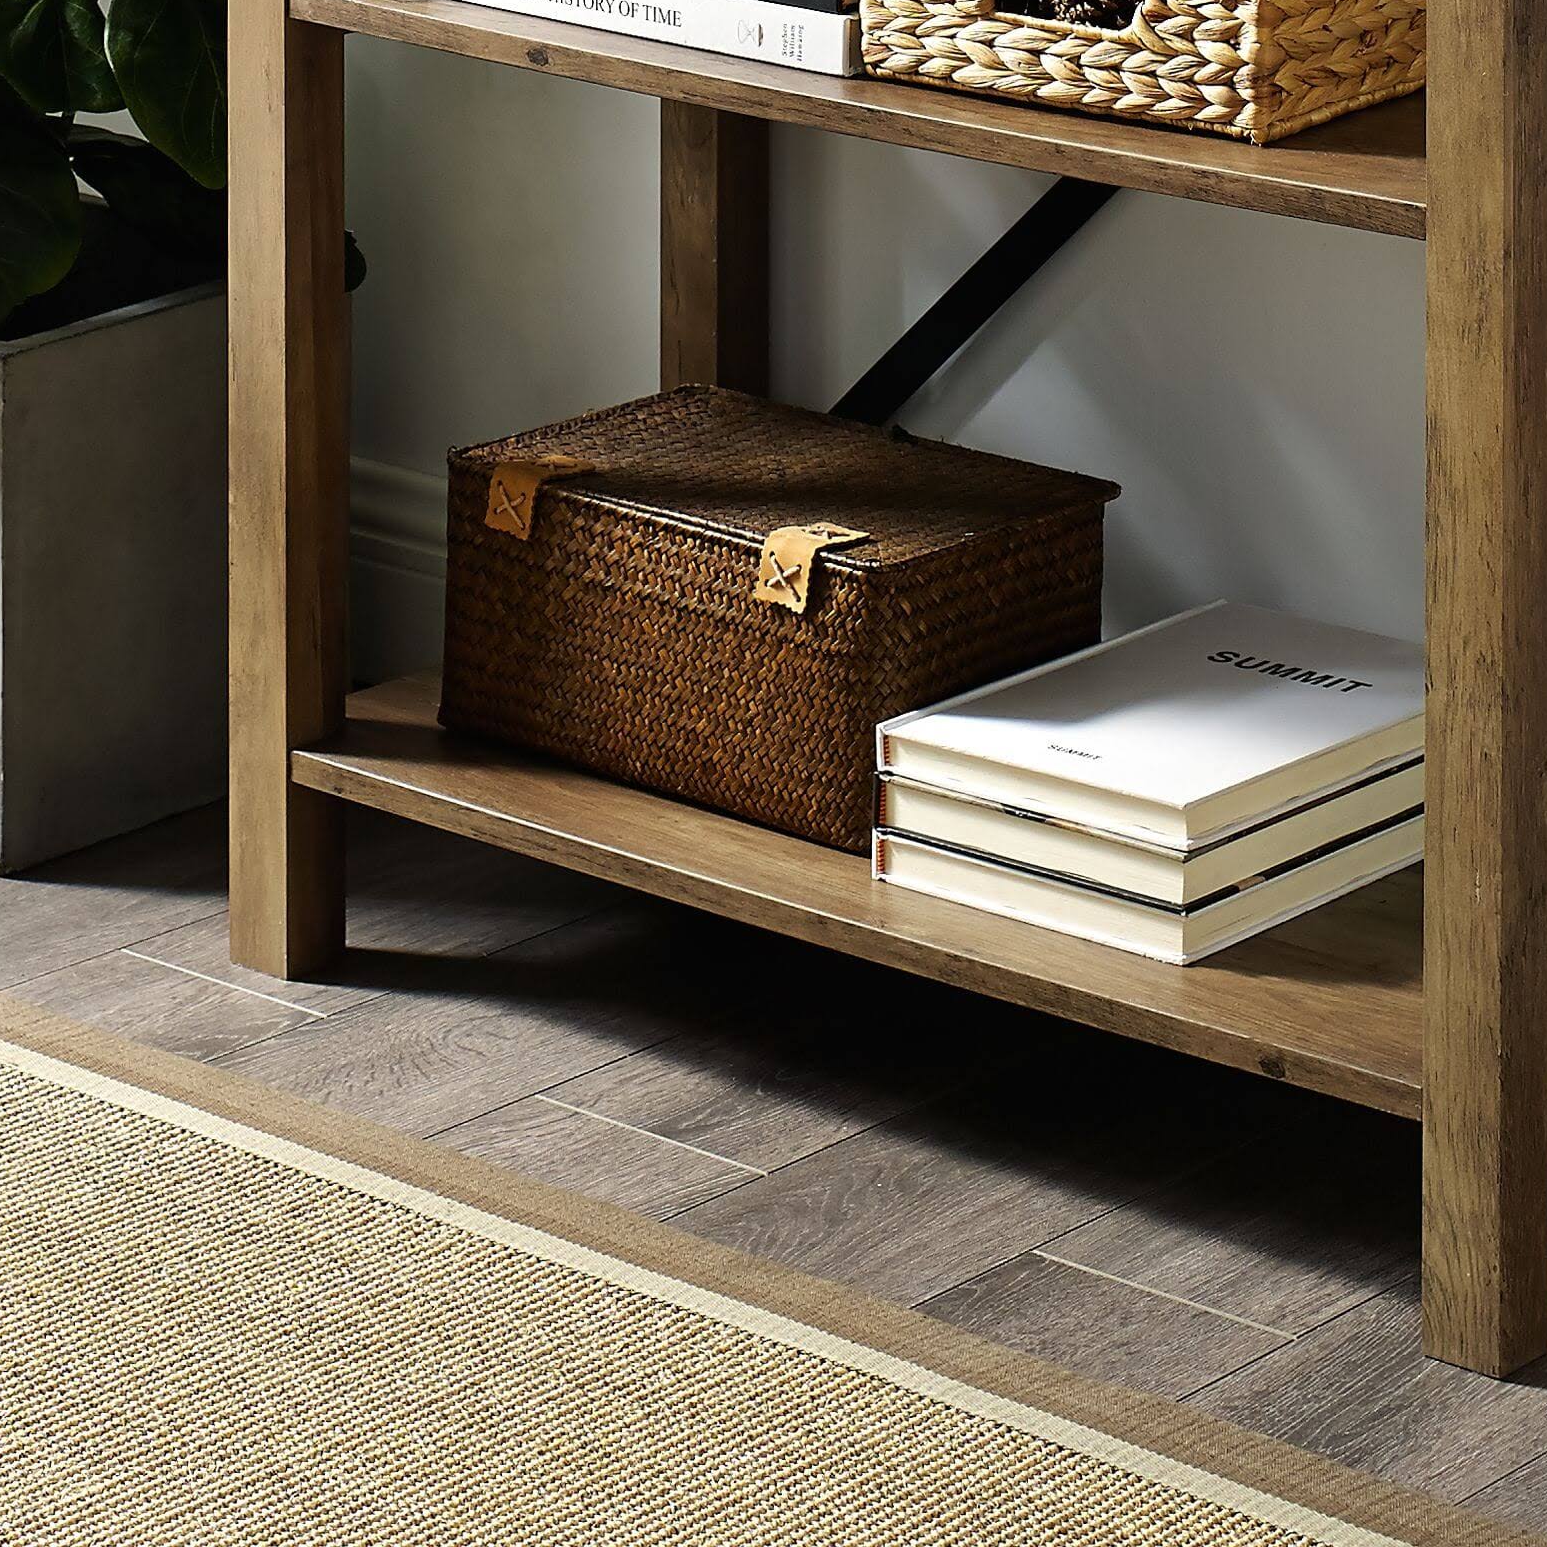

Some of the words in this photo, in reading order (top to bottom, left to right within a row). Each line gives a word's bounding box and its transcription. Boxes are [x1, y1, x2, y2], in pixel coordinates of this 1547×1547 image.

[618, 0, 640, 18] OF
[642, 4, 682, 28] TIME
[1207, 651, 1373, 693] SUMMIT
